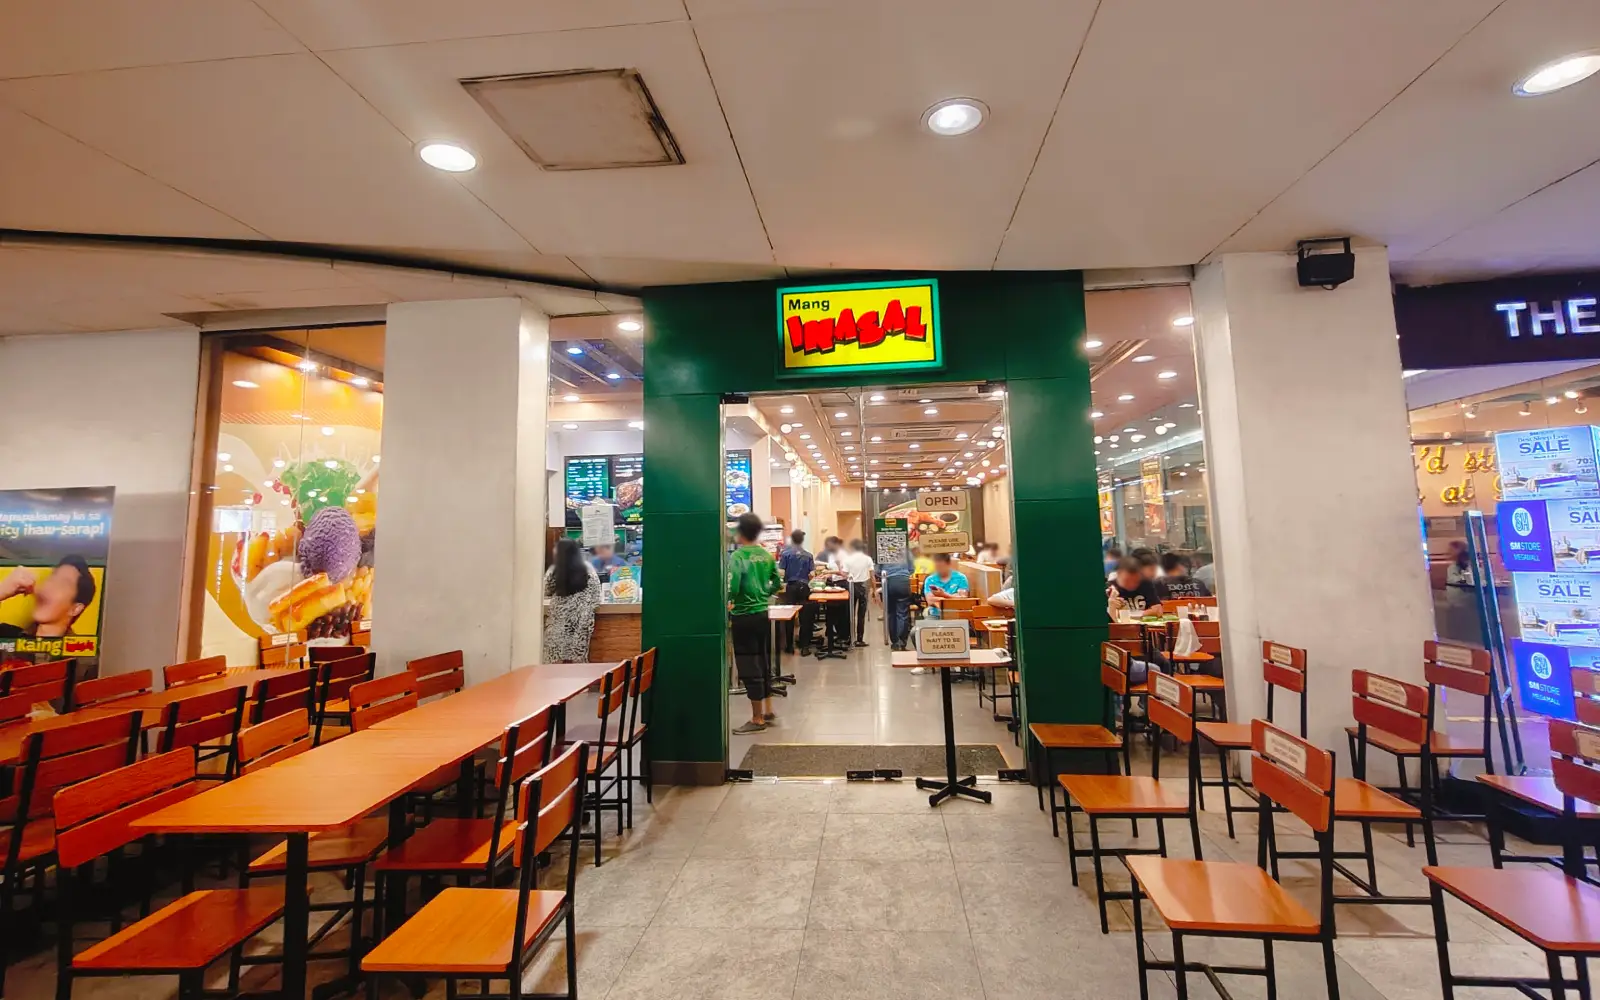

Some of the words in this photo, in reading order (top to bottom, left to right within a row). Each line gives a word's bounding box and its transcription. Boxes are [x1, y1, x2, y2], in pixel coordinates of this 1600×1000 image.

[788, 299, 831, 311] Mang
[1496, 298, 1600, 338] THE
[786, 299, 927, 356] INASAL
[1519, 439, 1571, 454] SALE
[924, 496, 958, 507] OPEN
[23, 522, 105, 539] ihaw-sarap!
[1538, 584, 1592, 597] SALE
[16, 638, 63, 656] Kaing
